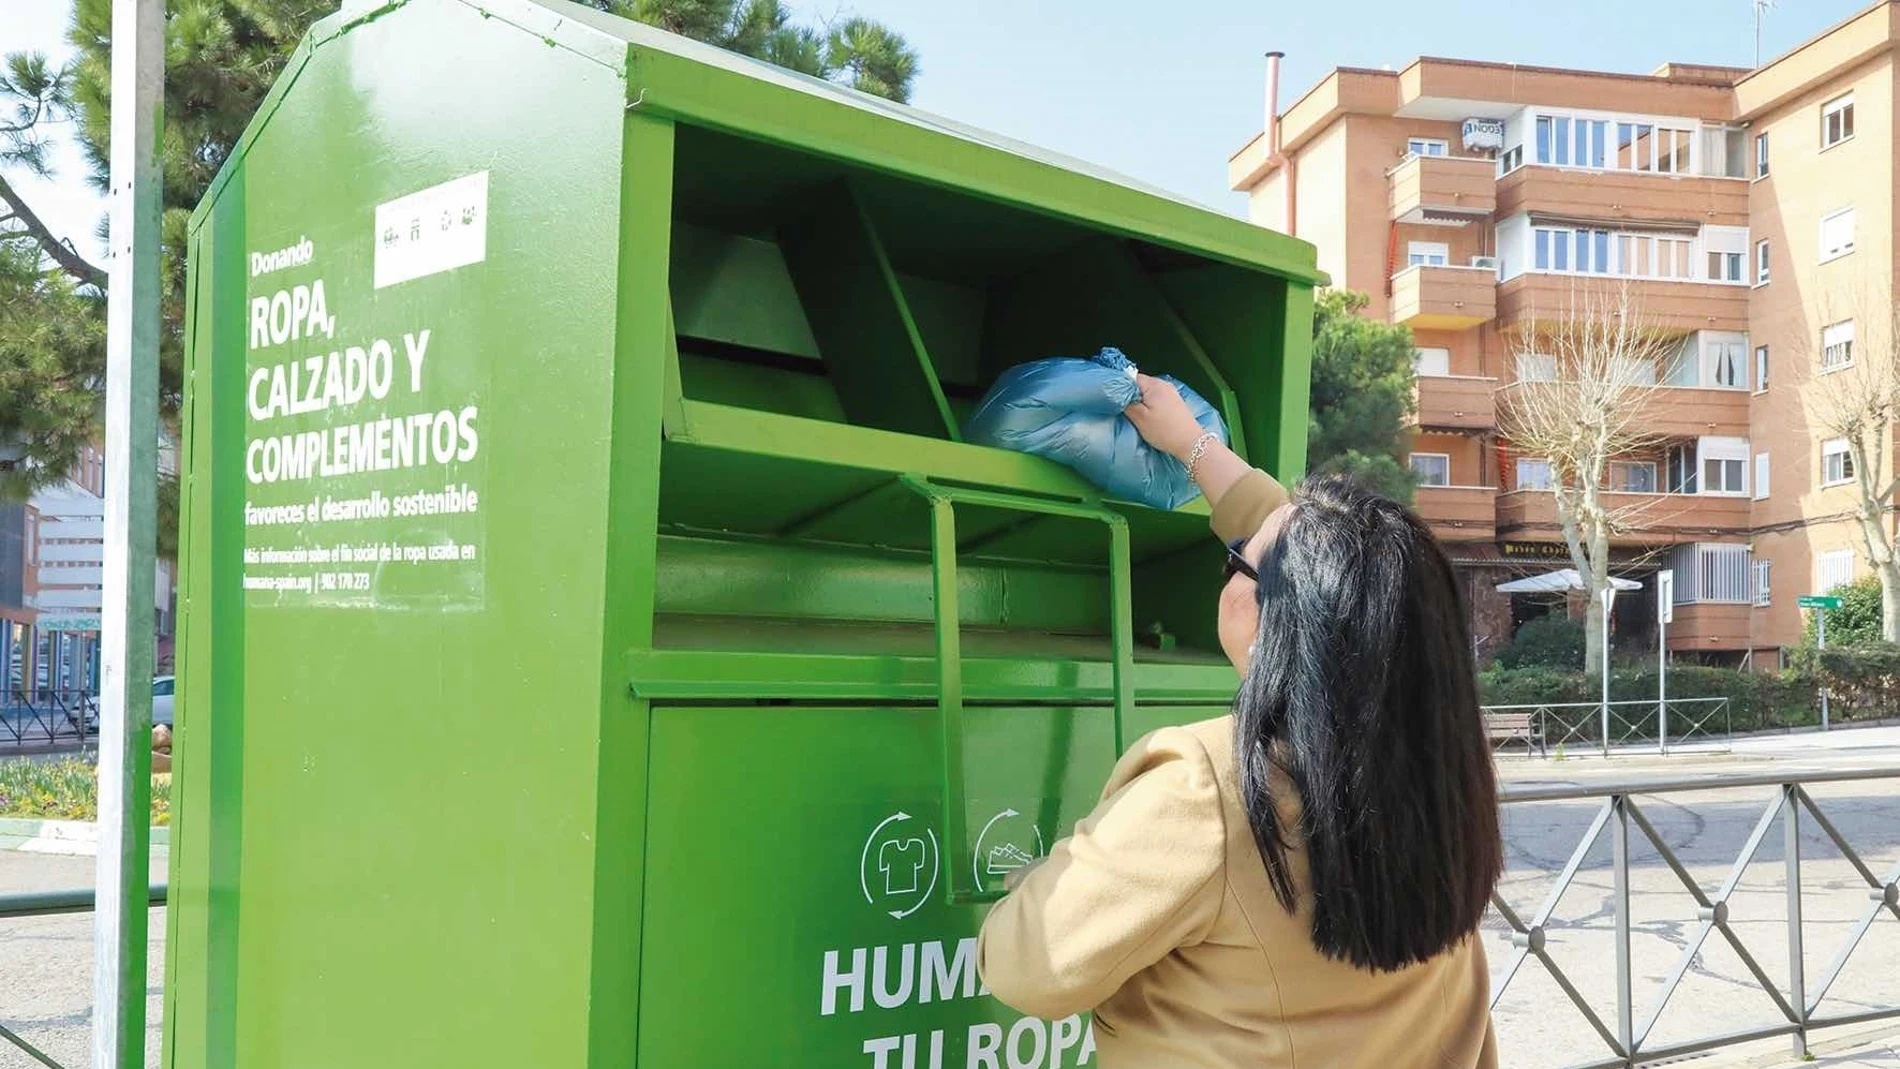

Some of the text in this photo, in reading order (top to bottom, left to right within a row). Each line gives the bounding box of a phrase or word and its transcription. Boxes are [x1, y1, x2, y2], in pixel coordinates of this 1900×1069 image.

[250, 235, 314, 277] Donando
[250, 278, 336, 350] ROPA,
[248, 329, 431, 420] CALZADO Y
[246, 405, 479, 484] COMPLEMENTOS
[245, 483, 479, 525] favoreces el desarrollo sostenible
[353, 541, 378, 562] social
[379, 541, 392, 561] de
[392, 541, 402, 560] la
[403, 545, 427, 565] ropa
[428, 539, 460, 560] usada
[461, 544, 476, 560] en
[821, 937, 992, 1016] HUM
